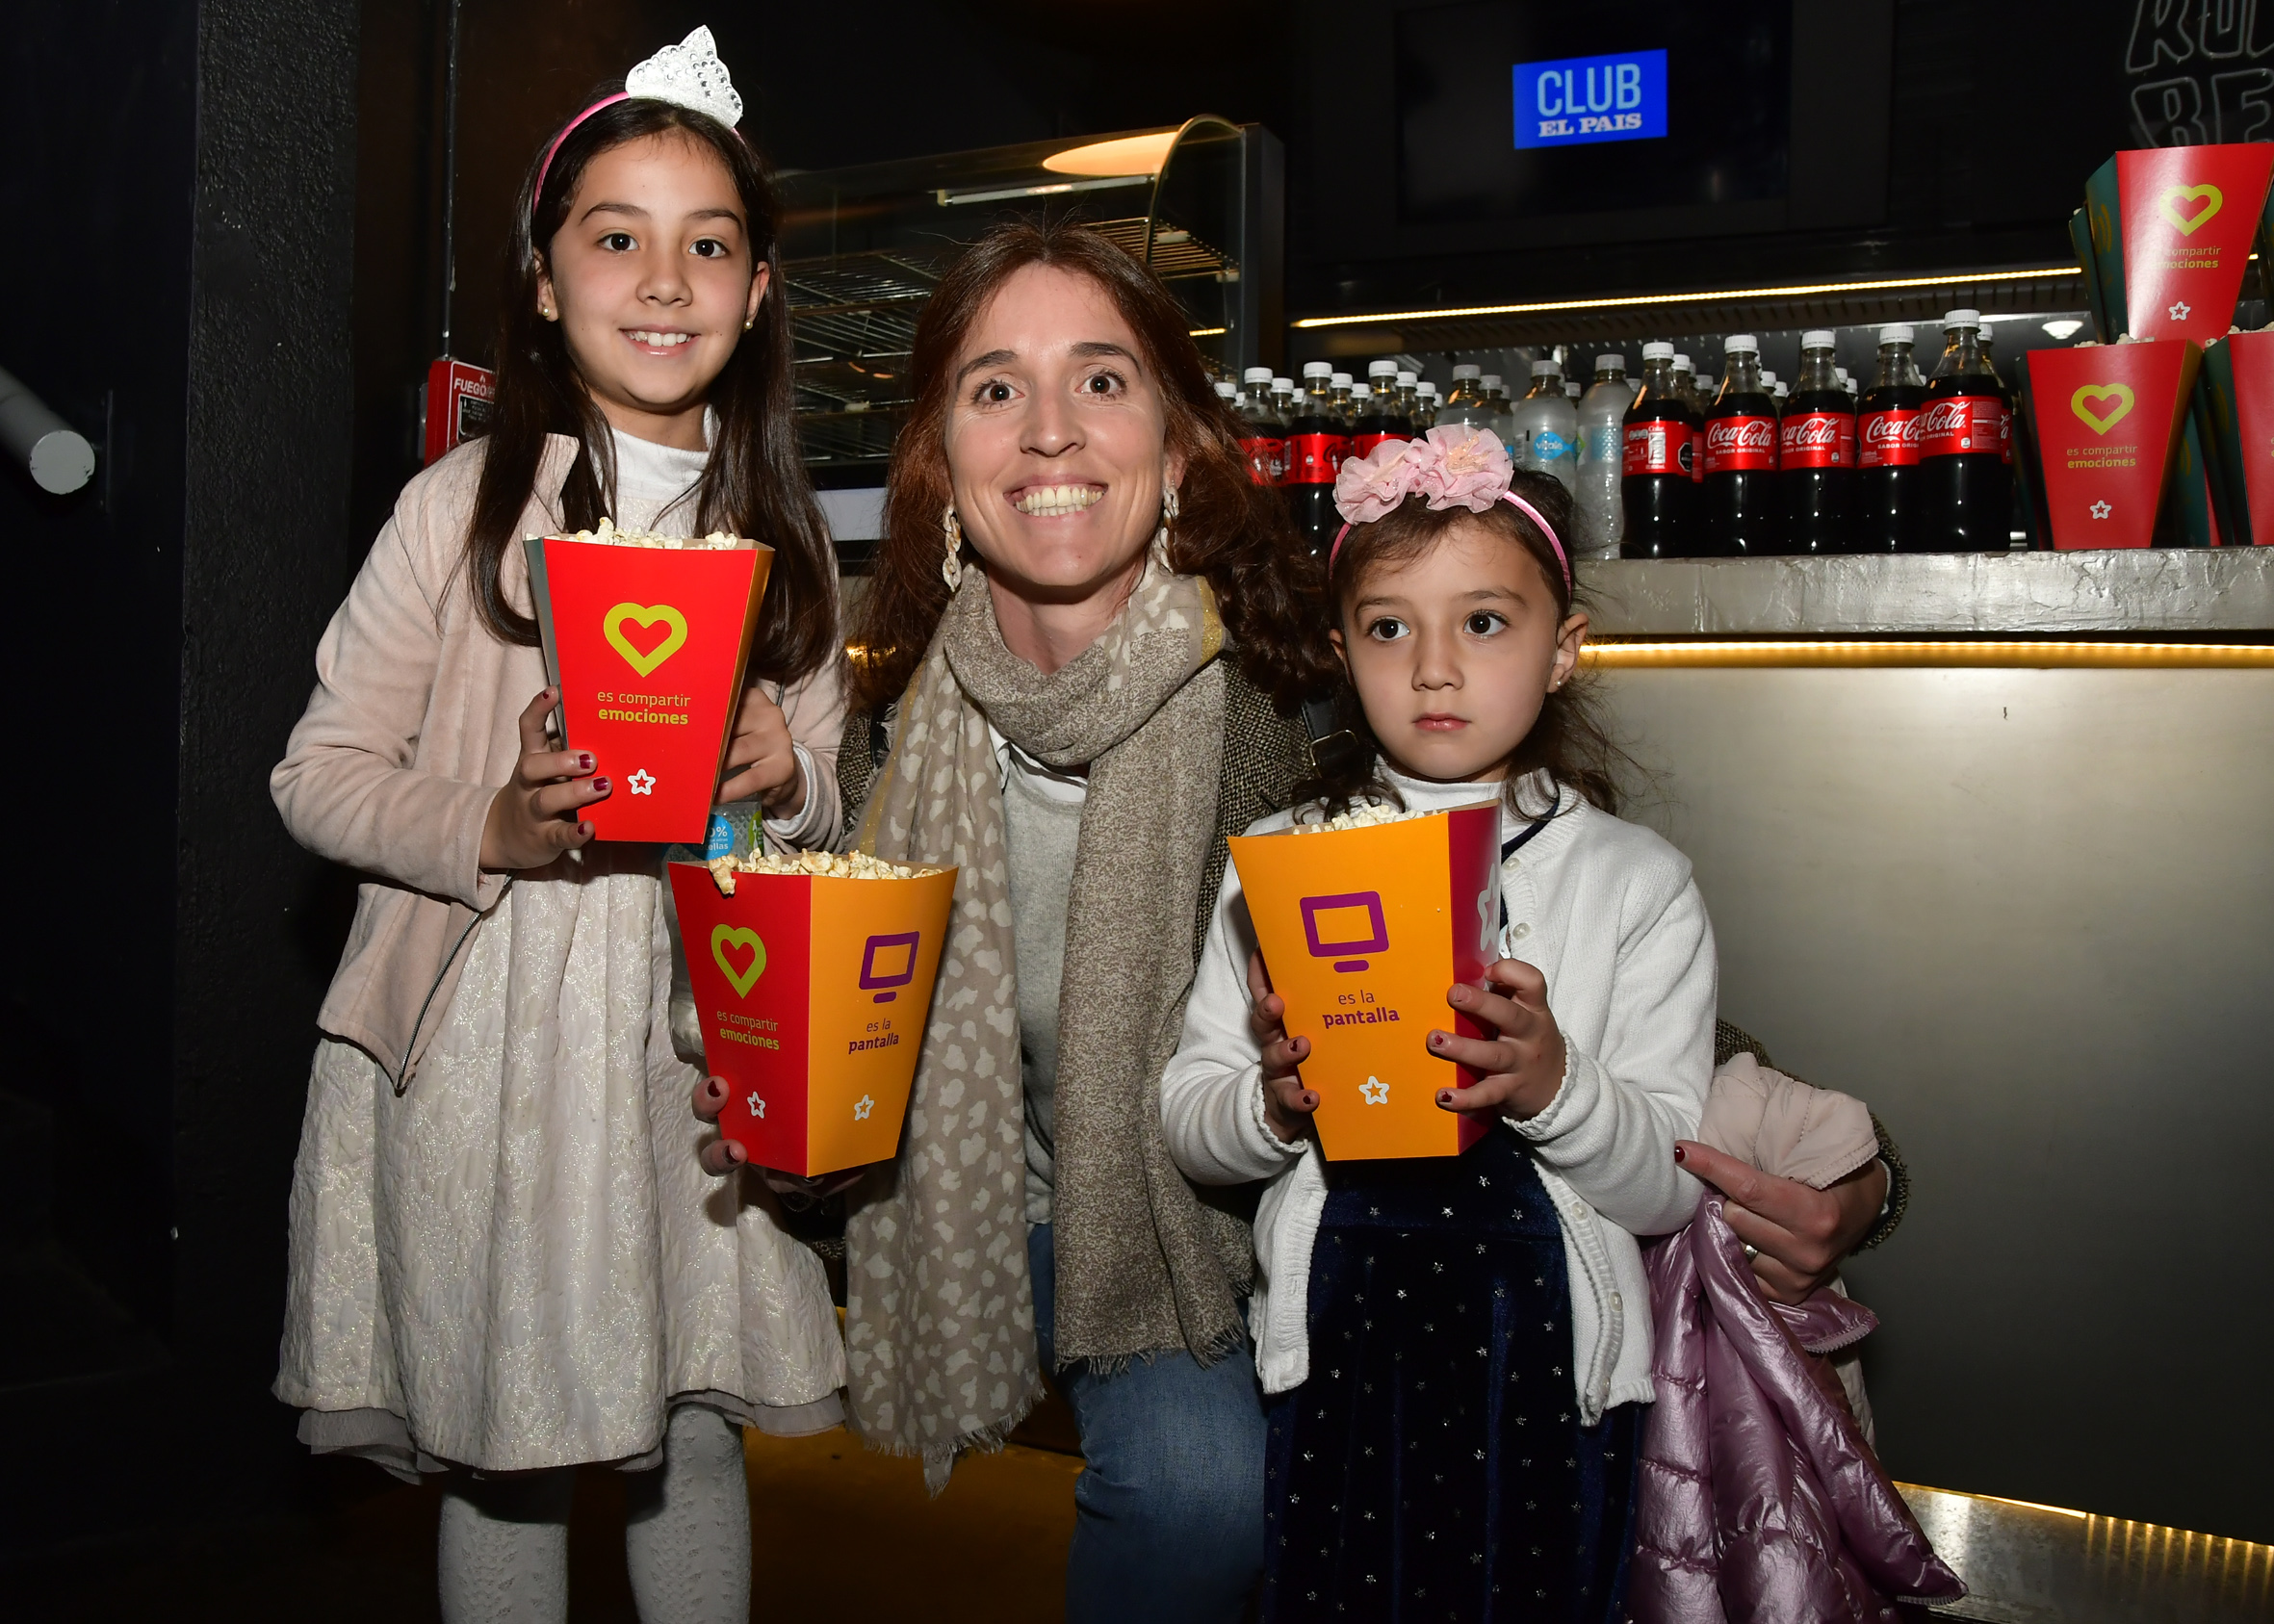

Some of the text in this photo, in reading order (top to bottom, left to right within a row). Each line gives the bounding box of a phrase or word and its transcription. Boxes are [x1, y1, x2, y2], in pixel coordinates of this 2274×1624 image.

[1537, 63, 1641, 116] CLUB
[1538, 113, 1642, 138] EL PAIS
[453, 377, 487, 397] FUEGO
[1707, 420, 1772, 450] Coca-Cola
[2067, 445, 2138, 457] es compartir
[2067, 457, 2136, 469] emociones
[597, 691, 691, 708] es compartir
[598, 709, 689, 725] emociones
[1338, 990, 1375, 1005] es la
[716, 1011, 779, 1032] es compartir
[866, 1018, 892, 1033] es la
[1323, 1007, 1400, 1029] pantalla
[720, 1027, 780, 1051] emociones
[848, 1032, 899, 1055] pantalla
